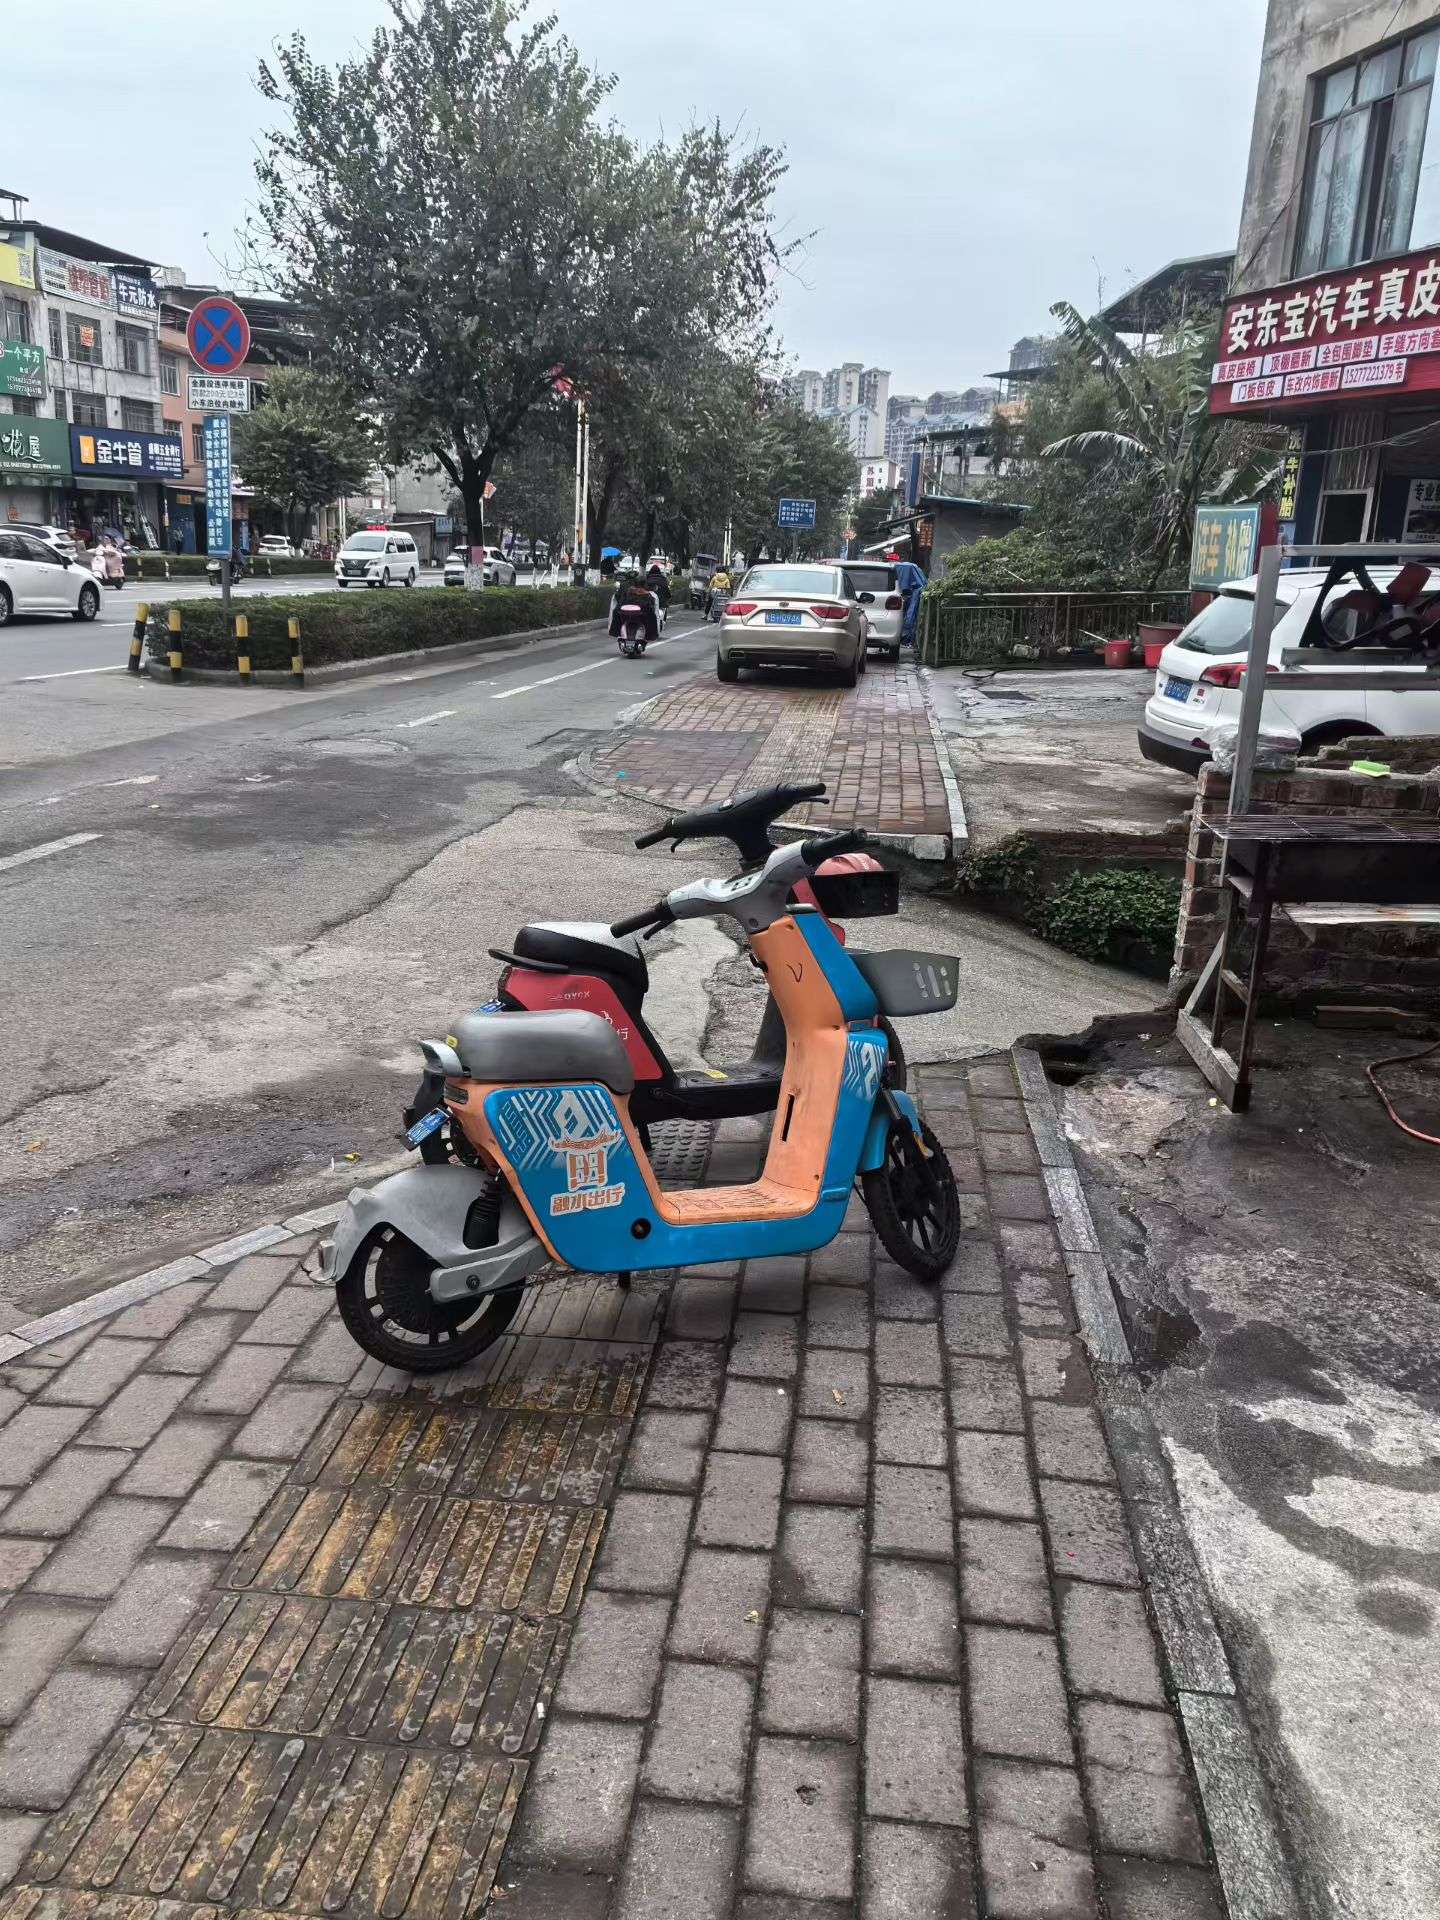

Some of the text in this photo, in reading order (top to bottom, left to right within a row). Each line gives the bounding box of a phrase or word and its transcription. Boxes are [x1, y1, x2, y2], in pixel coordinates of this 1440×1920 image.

[1227, 259, 1440, 354] 安东宝汽车真皮
[97, 439, 142, 467] 金牛管
